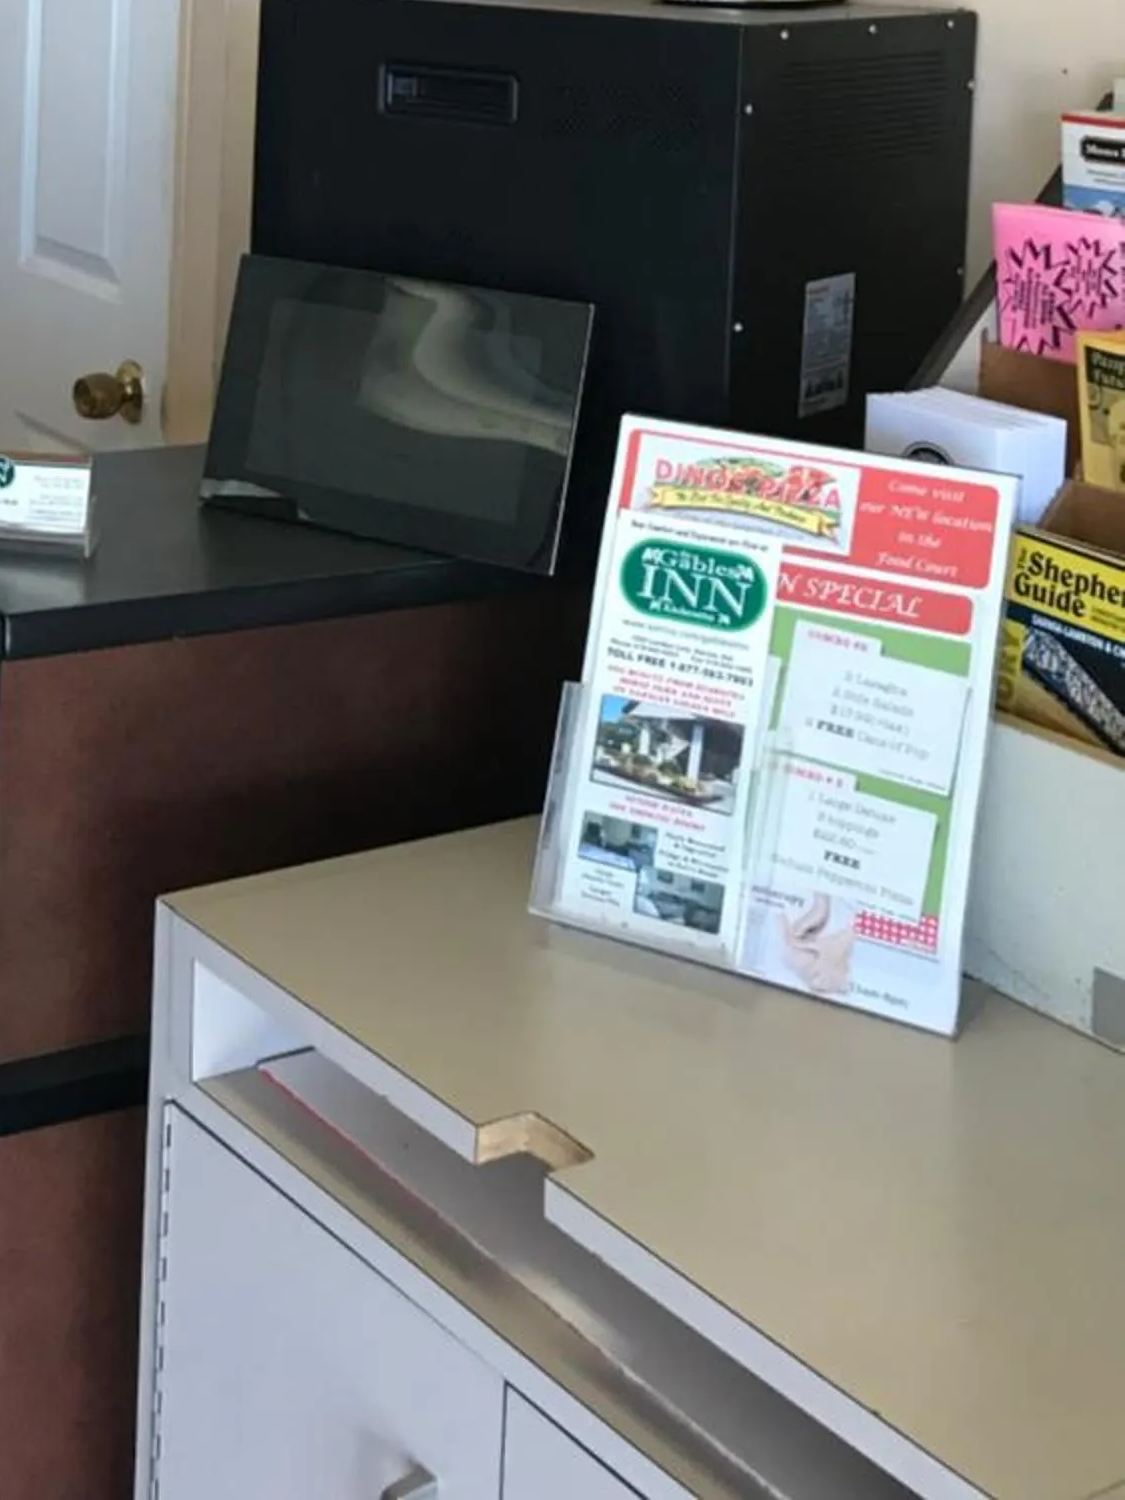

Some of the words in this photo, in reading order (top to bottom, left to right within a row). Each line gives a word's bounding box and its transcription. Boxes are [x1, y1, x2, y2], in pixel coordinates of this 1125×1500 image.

[932, 487, 966, 503] visit
[660, 548, 739, 580] Gables
[915, 558, 960, 579] Court
[637, 562, 752, 619] INN
[803, 577, 923, 618] SPECIAL
[1013, 571, 1087, 618] Guide
[637, 652, 667, 669] FREE
[816, 719, 855, 739] FREE
[823, 849, 862, 871] FREE
